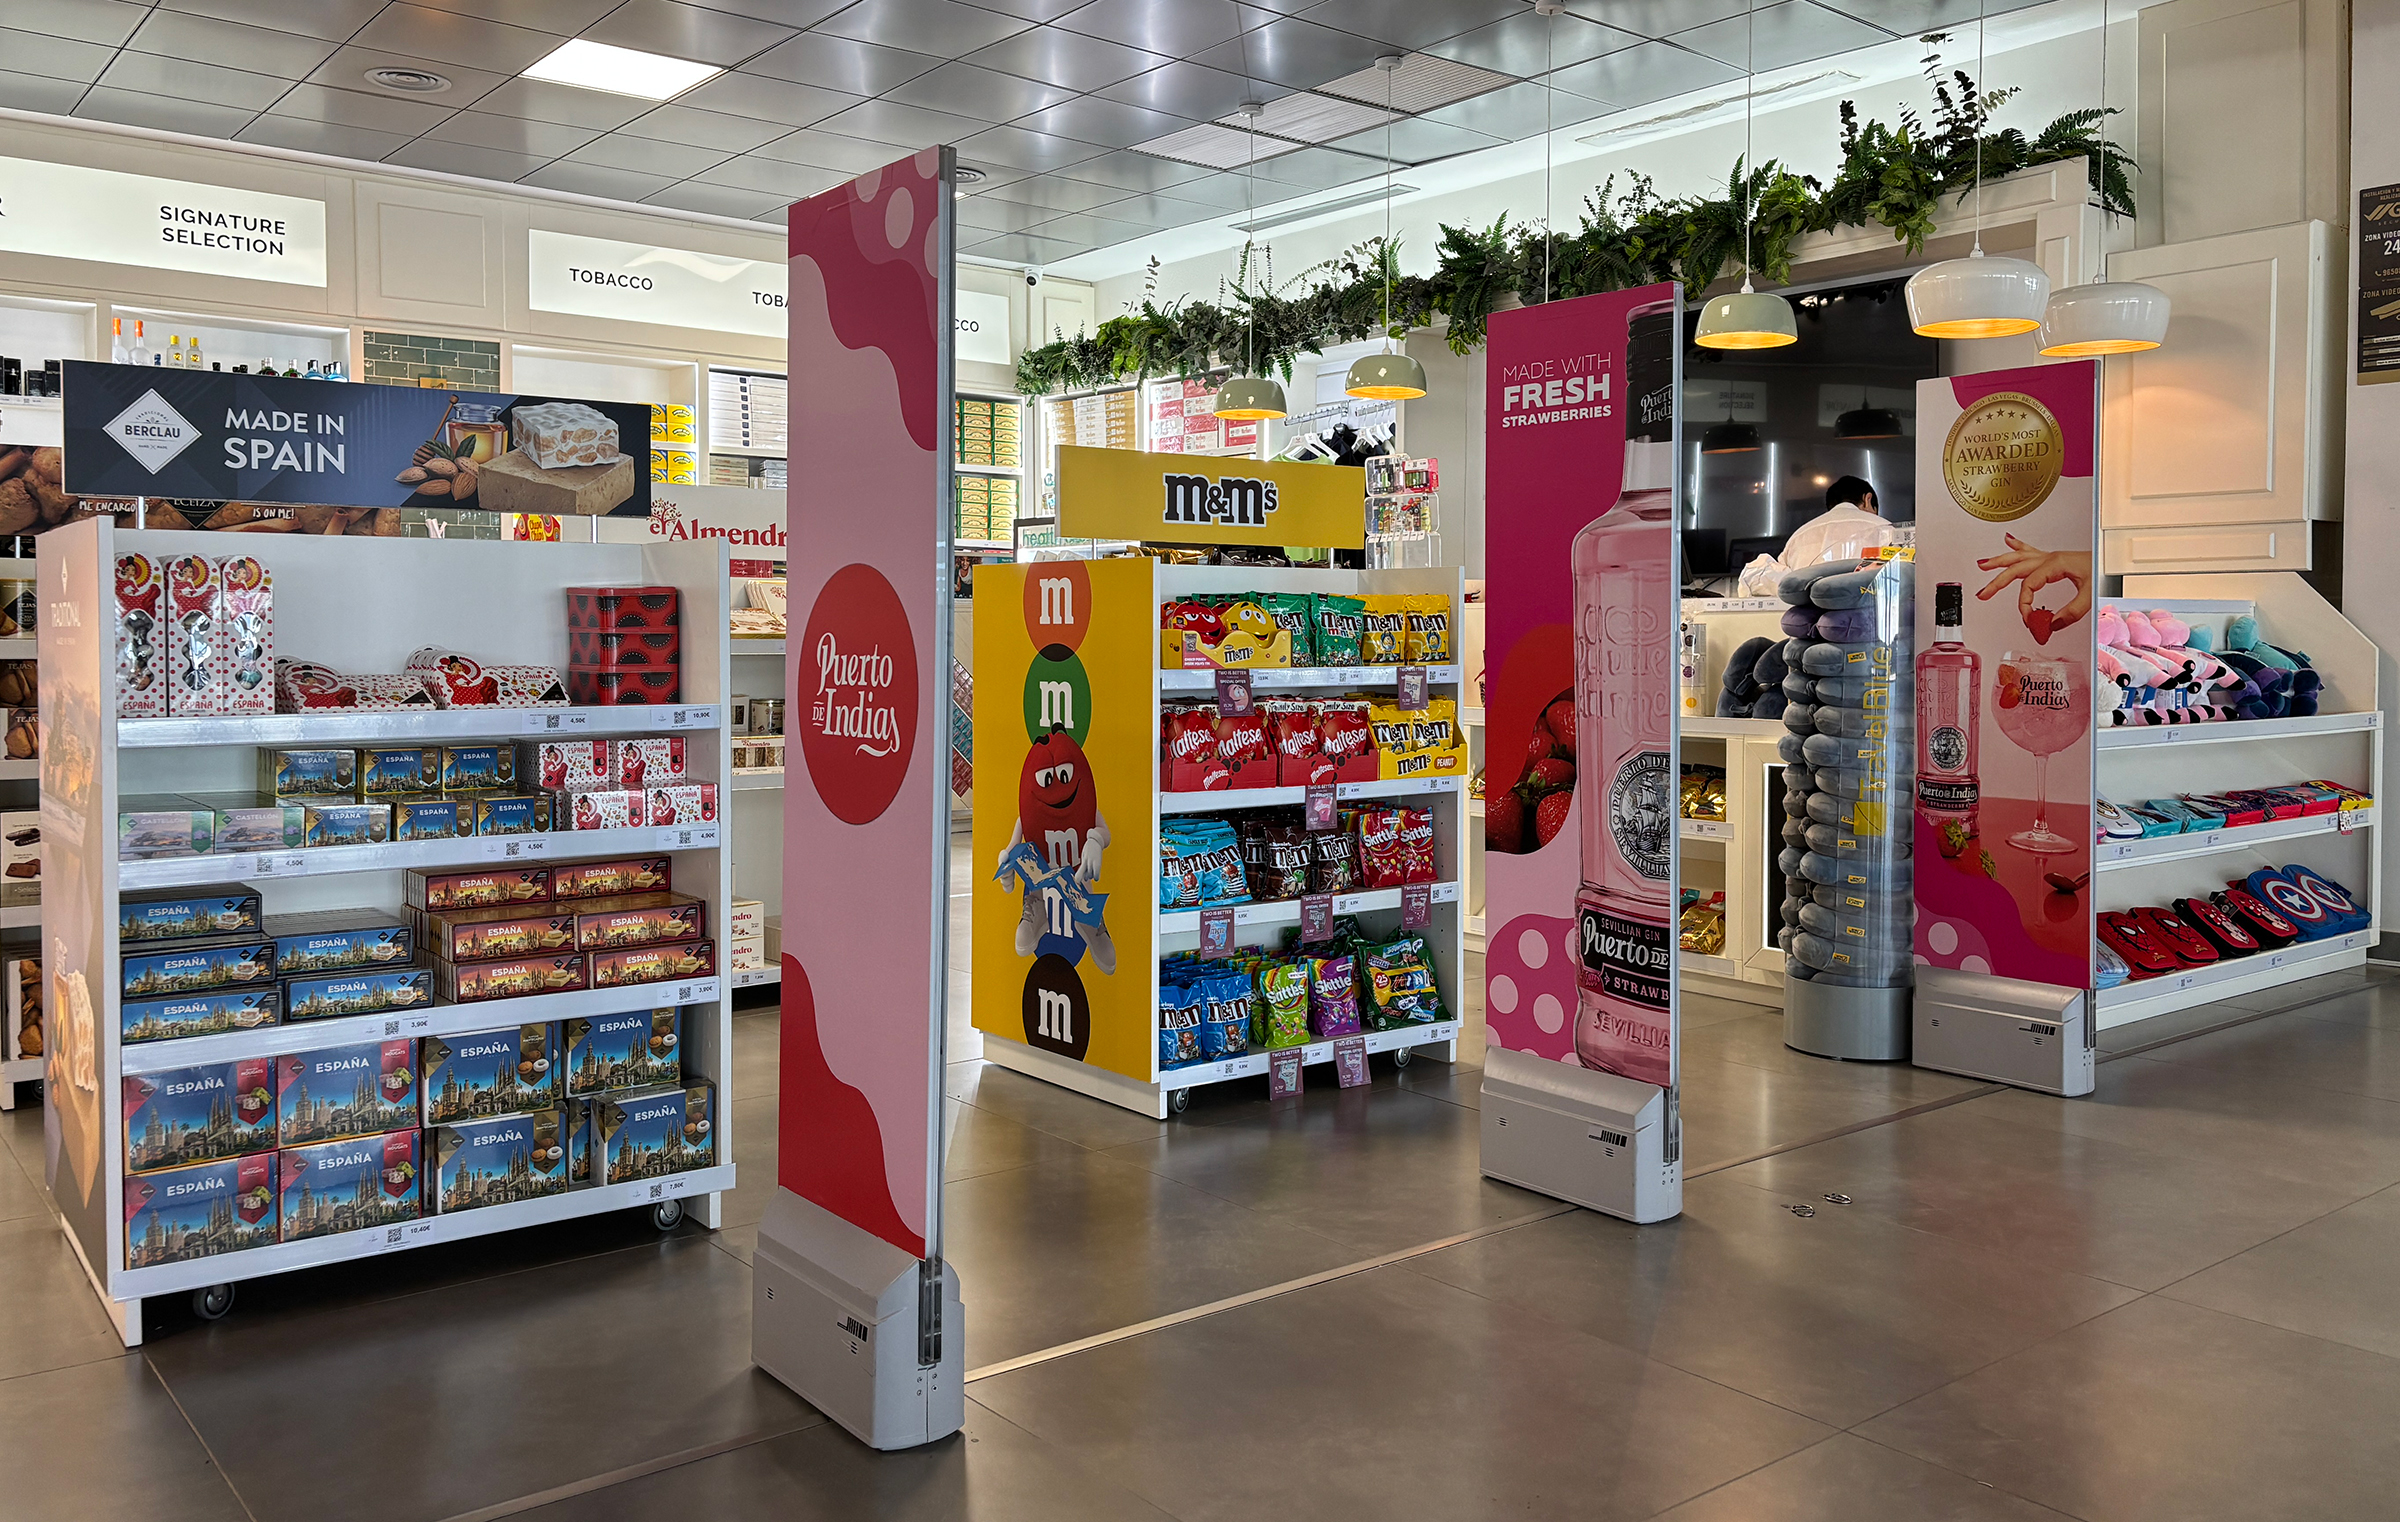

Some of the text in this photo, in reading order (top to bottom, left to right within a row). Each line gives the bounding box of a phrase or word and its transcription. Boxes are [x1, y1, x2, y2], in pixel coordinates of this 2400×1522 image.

[160, 205, 286, 236] SIGNATURE
[162, 227, 284, 256] SELECTION
[2365, 233, 2381, 242] ZONA
[569, 268, 653, 291] TOBACCO
[2363, 291, 2380, 299] ZONA
[1503, 352, 1611, 383] MADE WITH
[1503, 373, 1610, 412] FRESH
[225, 407, 344, 436] MADE IN
[1502, 405, 1612, 428] STRAWBERRIES
[1962, 400, 1985, 420] CHICAGO
[2021, 396, 2046, 415] BRUSSELS
[2047, 414, 2059, 437] DALLAS
[125, 425, 180, 438] BERCLAU
[1947, 422, 1961, 446] LONDON
[1964, 429, 2041, 444] WORLD'S MOST
[223, 437, 345, 475] SPAIN
[1956, 441, 2050, 464] AWARDED
[1963, 461, 2041, 476] STRAWBERRY
[1990, 477, 2011, 488] GIN
[79, 501, 93, 511] ME
[96, 500, 136, 513] ENCARGO
[1164, 474, 1277, 526] m&m's
[253, 508, 295, 520] IS ON ME!
[1967, 505, 1978, 514] SAN
[1038, 578, 1074, 625] m
[1224, 647, 1254, 663] m&m's
[816, 632, 893, 696] Puerto
[2019, 674, 2063, 694] Puerto
[123, 700, 156, 711] ESPAÑA
[180, 699, 214, 710] ESPAÑA
[232, 699, 265, 709] ESPAÑA
[1038, 680, 1074, 729] m
[1291, 702, 1304, 711] Size
[1341, 702, 1355, 710] Size
[2023, 690, 2070, 711] Indias
[570, 716, 586, 724] 4,50€
[812, 706, 825, 721] DE
[822, 688, 900, 757] Indias
[568, 746, 590, 754] ESPAÑA
[645, 744, 667, 752] ESPAÑA
[298, 755, 329, 764] ESPAÑA
[385, 754, 414, 763] ESPAÑA
[463, 752, 491, 760] ESPAÑA
[1397, 753, 1454, 775] m&m's PEANUT
[1612, 757, 1647, 811] PUERTO
[675, 791, 697, 799] ESPAÑA
[1918, 782, 1978, 801] Puerto Indias
[499, 803, 527, 812] ESPAÑA
[235, 812, 279, 821] CASTELLÓN
[329, 811, 361, 820] ESPAÑA
[527, 842, 543, 851] 4,50€
[285, 859, 304, 867] 4,50€
[585, 867, 617, 877] ESPAÑA
[459, 877, 494, 888] ESPAÑA
[148, 905, 191, 917] ESPAÑA
[611, 915, 644, 926] ESPAÑA
[488, 925, 523, 936] ESPAÑA
[1601, 917, 1660, 941] SEVILLIAN GIN
[308, 937, 348, 949] ESPAÑA
[1583, 916, 1669, 966] Puerto DE
[164, 957, 207, 970] ESPAÑA
[626, 953, 659, 964] ESPAÑA
[491, 965, 527, 977] ESPAÑA
[328, 981, 367, 993] ESPAÑA
[163, 1002, 208, 1015] ESPAÑA
[1037, 987, 1074, 1044] m
[599, 1018, 643, 1033] ESPAÑA
[460, 1042, 510, 1058] ESPAÑA
[315, 1056, 370, 1073] ESPAÑA
[166, 1077, 225, 1095] ESPAÑA
[634, 1105, 677, 1123] ESPAÑA
[473, 1129, 523, 1147] ESPAÑA
[318, 1152, 373, 1170] ESPAÑA
[166, 1177, 226, 1197] ESPAÑA
[410, 1224, 431, 1234] 10,40€
